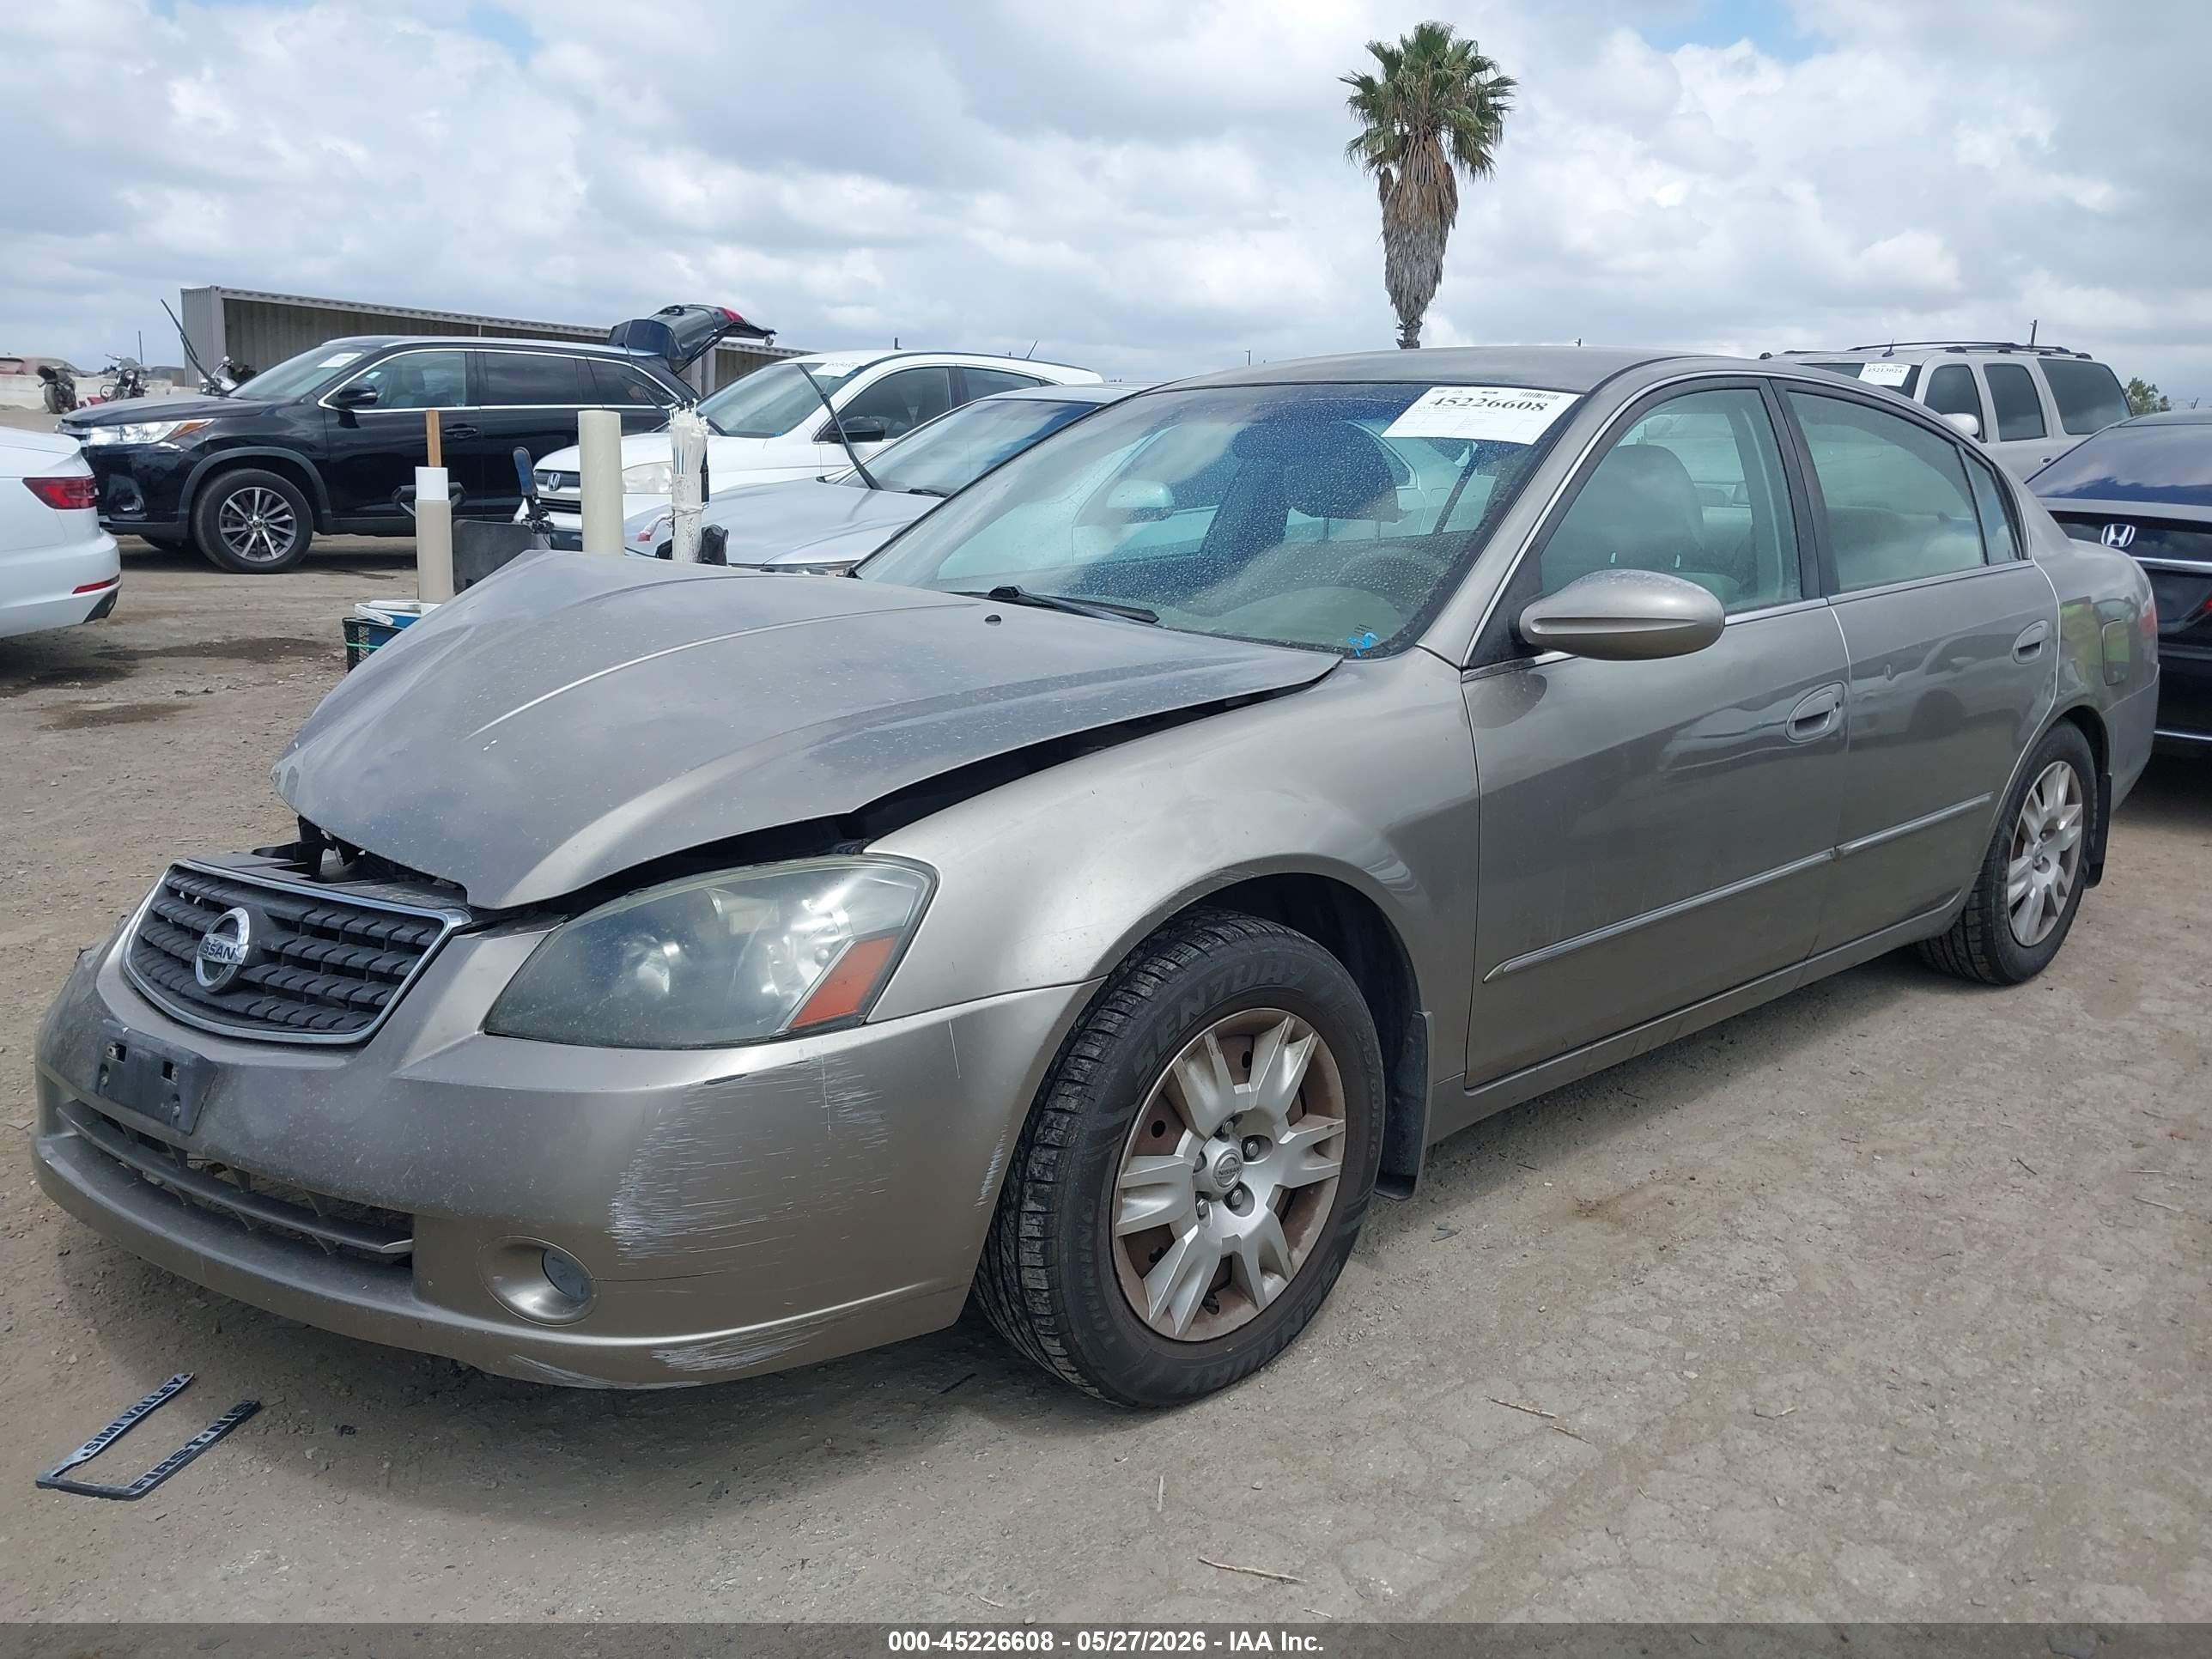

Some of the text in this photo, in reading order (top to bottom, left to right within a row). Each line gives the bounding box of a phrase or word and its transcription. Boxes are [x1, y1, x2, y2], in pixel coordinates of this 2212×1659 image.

[1429, 397, 1548, 412] 45226608
[1218, 1166, 1242, 1176] NISSAN
[83, 1376, 183, 1452] SIMI VALLEY
